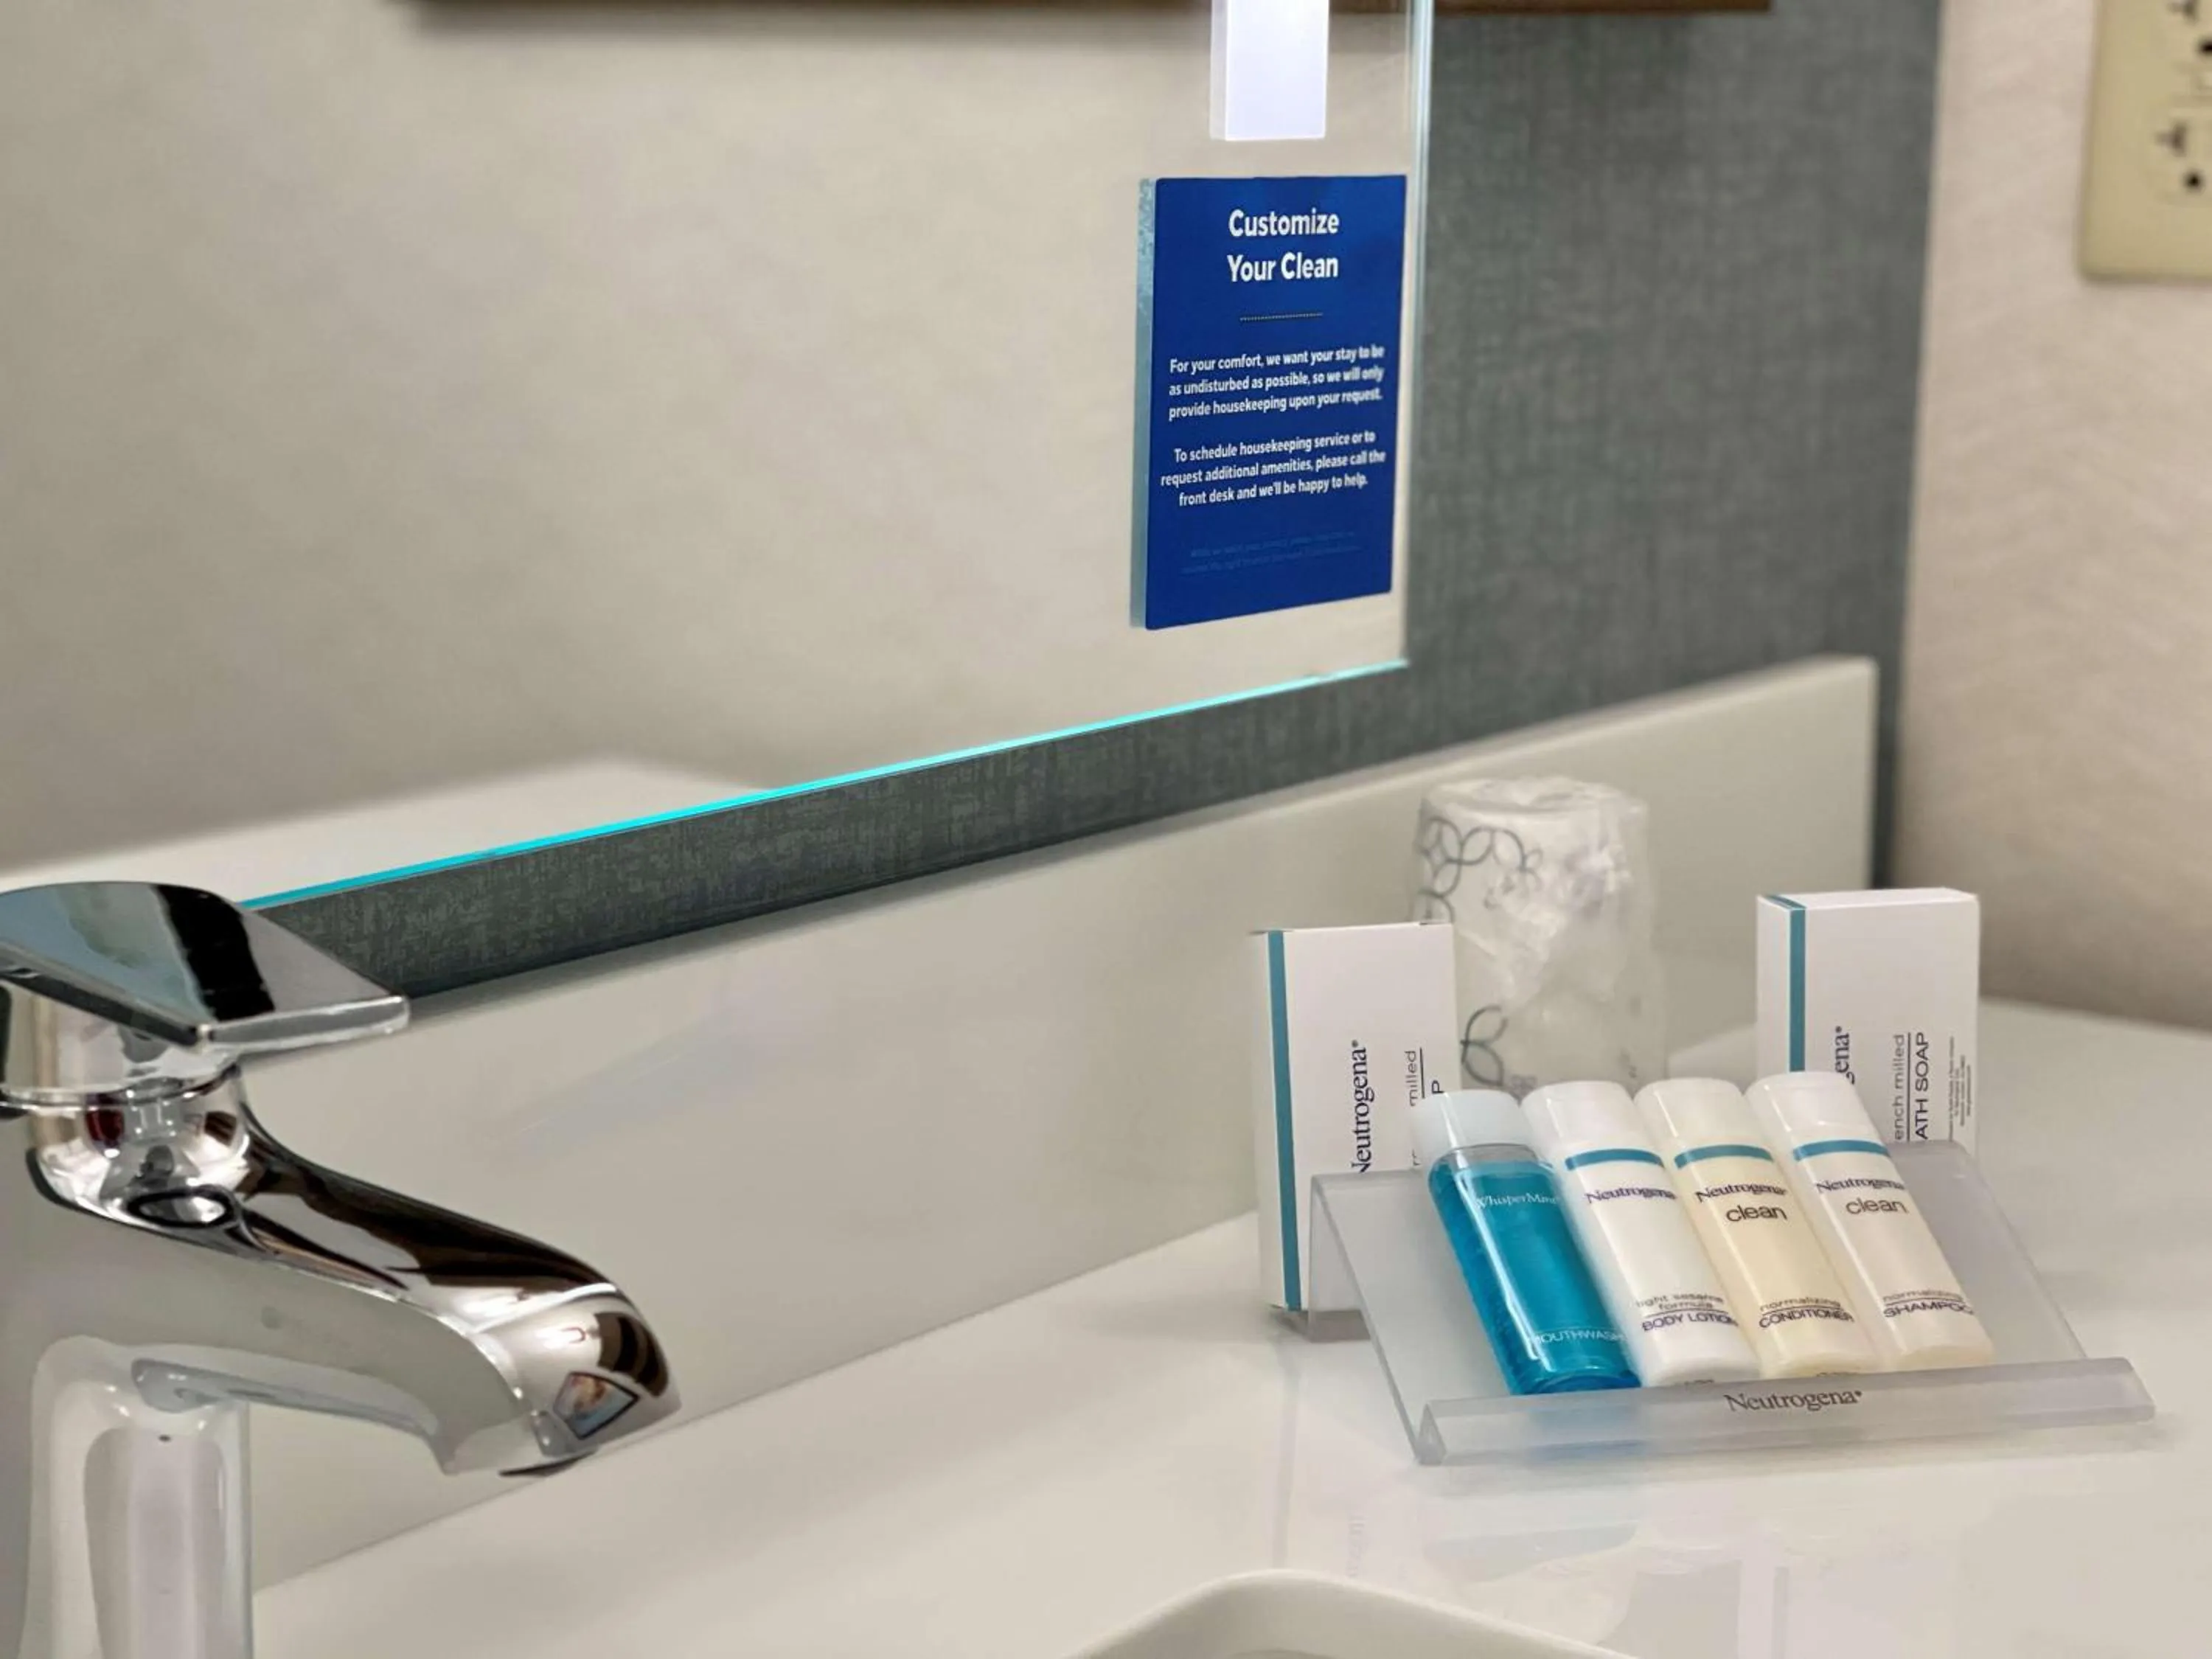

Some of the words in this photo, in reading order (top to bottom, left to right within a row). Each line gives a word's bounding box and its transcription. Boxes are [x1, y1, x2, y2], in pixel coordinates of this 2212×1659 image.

[1228, 207, 1340, 237] Customize
[1227, 254, 1276, 282] Your
[1281, 251, 1339, 279] Clean
[1169, 358, 1189, 374] For
[1191, 358, 1216, 375] your
[1217, 354, 1265, 369] comfort,
[1266, 354, 1281, 366] we
[1283, 350, 1308, 364] want
[1310, 350, 1334, 366] your
[1335, 347, 1357, 364] stay
[1359, 346, 1370, 358] to
[1371, 344, 1385, 358] be
[1169, 385, 1182, 396] as
[1183, 375, 1250, 394] undisturbed
[1251, 378, 1264, 389] as
[1265, 371, 1310, 392] possible,
[1312, 372, 1325, 384] so
[1327, 372, 1341, 383] we
[1343, 366, 1361, 380] will
[1362, 365, 1385, 383] only
[1169, 401, 1211, 422] provide
[1213, 395, 1287, 414] housekeeping
[1289, 394, 1315, 411] upon
[1317, 392, 1340, 409] your
[1341, 387, 1382, 405] request.
[1174, 448, 1187, 462] To
[1189, 443, 1238, 461] schedule
[1239, 437, 1312, 455] housekeeping
[1314, 432, 1350, 448] service
[1352, 433, 1363, 444] or
[1365, 430, 1376, 442] to
[1161, 470, 1203, 488] request
[1205, 462, 1259, 481] additional
[1261, 458, 1313, 475] amenities,
[1315, 455, 1349, 473] please
[1350, 450, 1367, 465] call
[1368, 449, 1386, 464] the
[1179, 492, 1207, 507] front
[1208, 487, 1235, 503] desk
[1237, 484, 1257, 500] and
[1259, 481, 1281, 496] we'll
[1284, 480, 1296, 494] be
[1298, 479, 1329, 494] happy
[1332, 476, 1343, 489] to
[1344, 472, 1368, 490] help.
[1893, 1034, 1905, 1089] milled
[1915, 1032, 1929, 1092] SOAP
[1893, 1096, 1905, 1140] ench
[1915, 1099, 1929, 1140] ATH
[1726, 1205, 1787, 1222] clean
[1846, 1197, 1909, 1214] clean
[1642, 1314, 1683, 1331] BODY
[1687, 1312, 1739, 1326] LOTION
[1759, 1310, 1854, 1328] CONDITIONER
